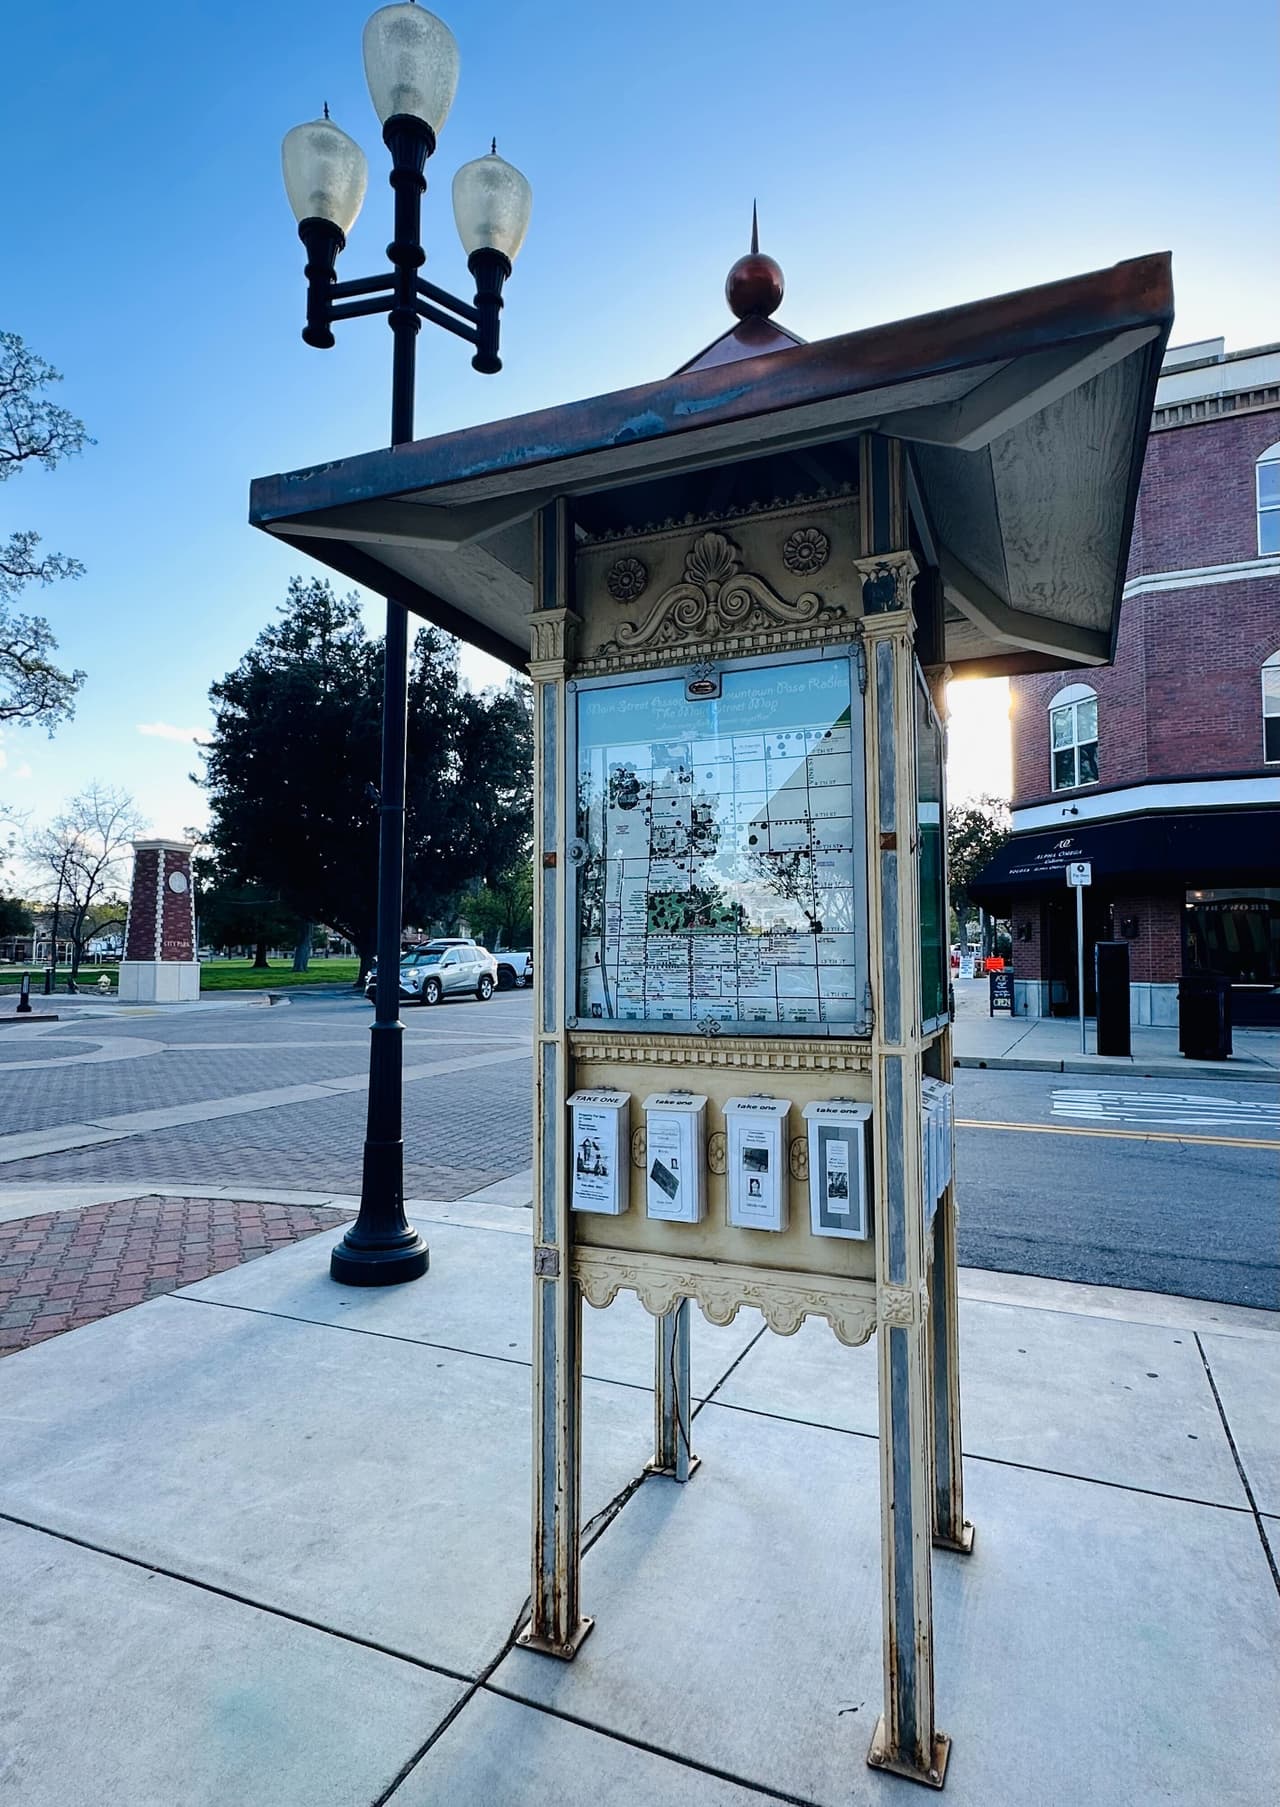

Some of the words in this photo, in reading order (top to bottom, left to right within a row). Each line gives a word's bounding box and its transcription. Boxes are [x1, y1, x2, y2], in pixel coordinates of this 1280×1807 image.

[616, 699, 649, 713] Street
[722, 686, 774, 699] owntown
[776, 680, 806, 694] Paso
[747, 697, 778, 713] Map
[575, 1094, 600, 1103] TAKE
[599, 1095, 620, 1104] ONE
